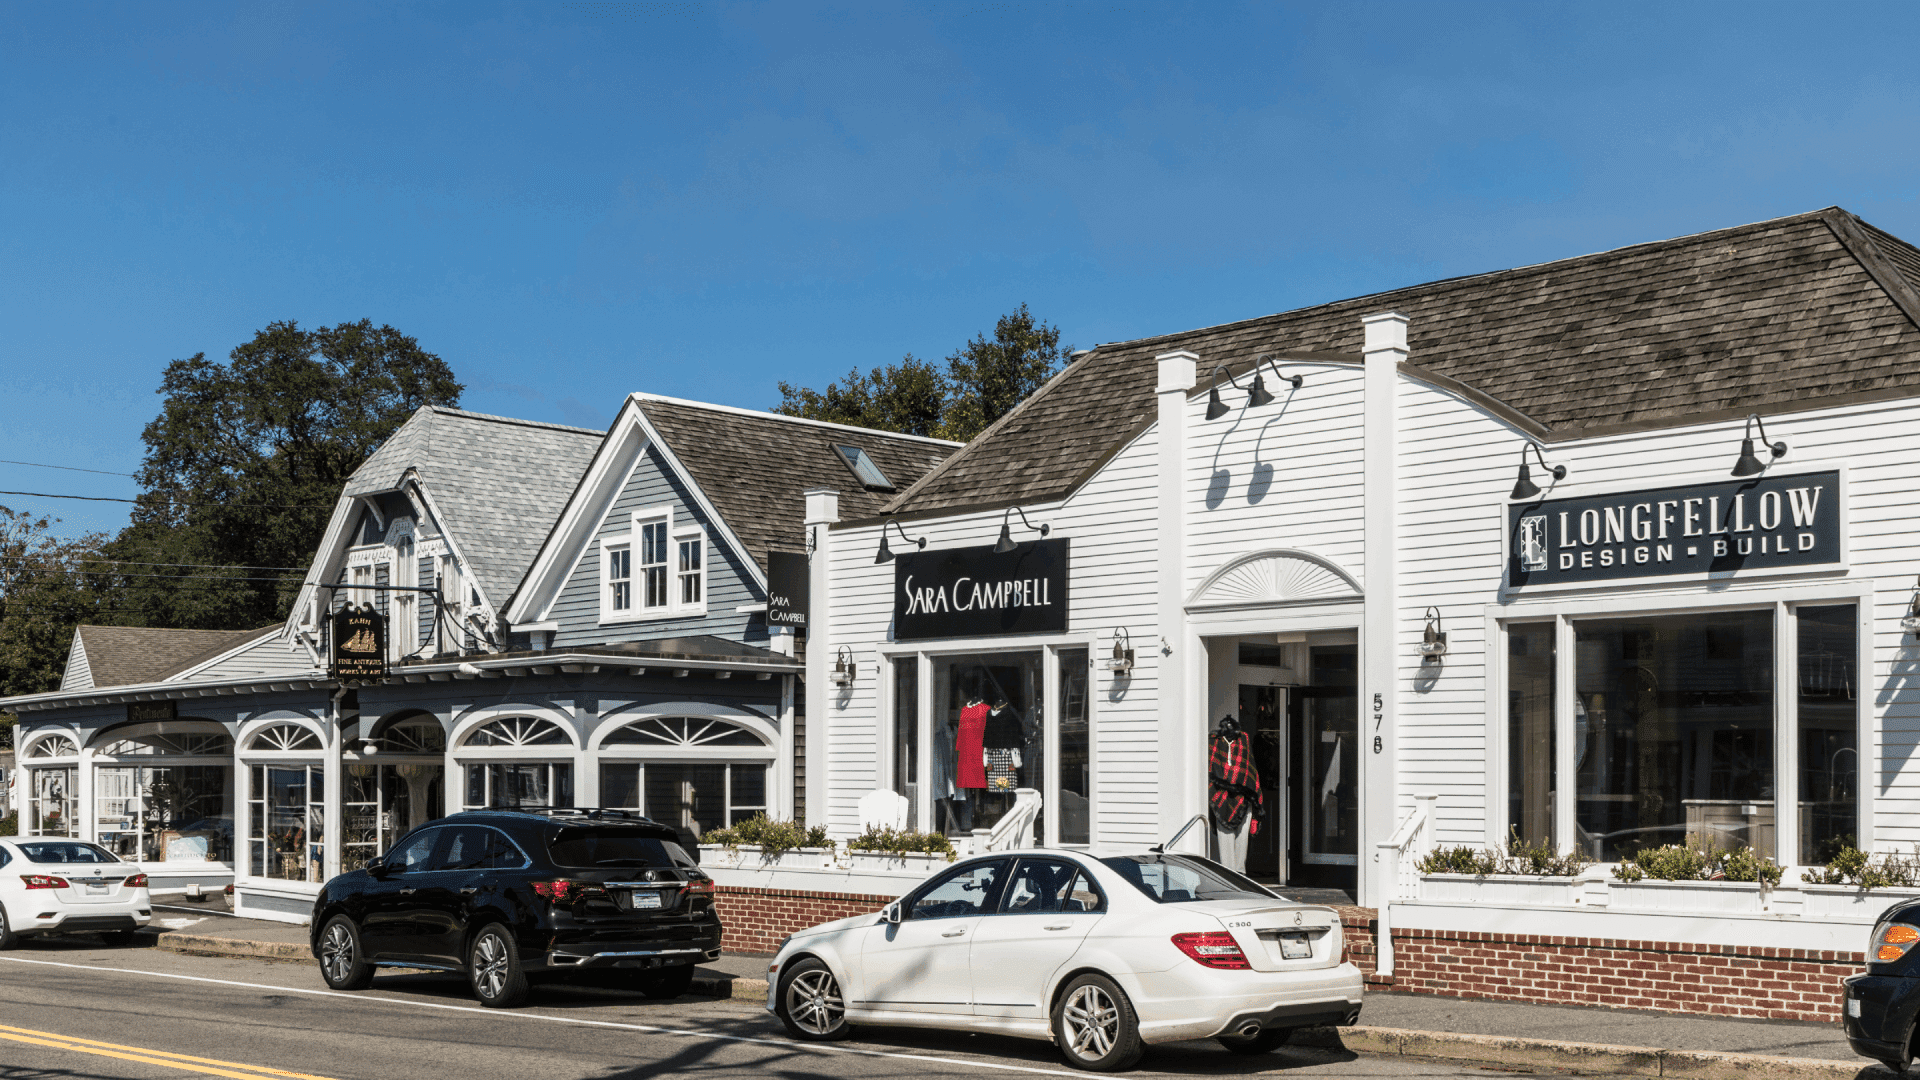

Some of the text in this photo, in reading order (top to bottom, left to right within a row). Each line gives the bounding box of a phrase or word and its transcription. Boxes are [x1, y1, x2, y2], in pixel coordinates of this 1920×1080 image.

[1559, 486, 1824, 548] LONGFELLOW
[1559, 533, 1816, 570] DESIGN BUILD
[770, 591, 790, 606] SARA
[905, 574, 1052, 615] SARA CAMPBELL
[769, 609, 805, 623] CAMPBELL
[1373, 693, 1383, 754] 578
